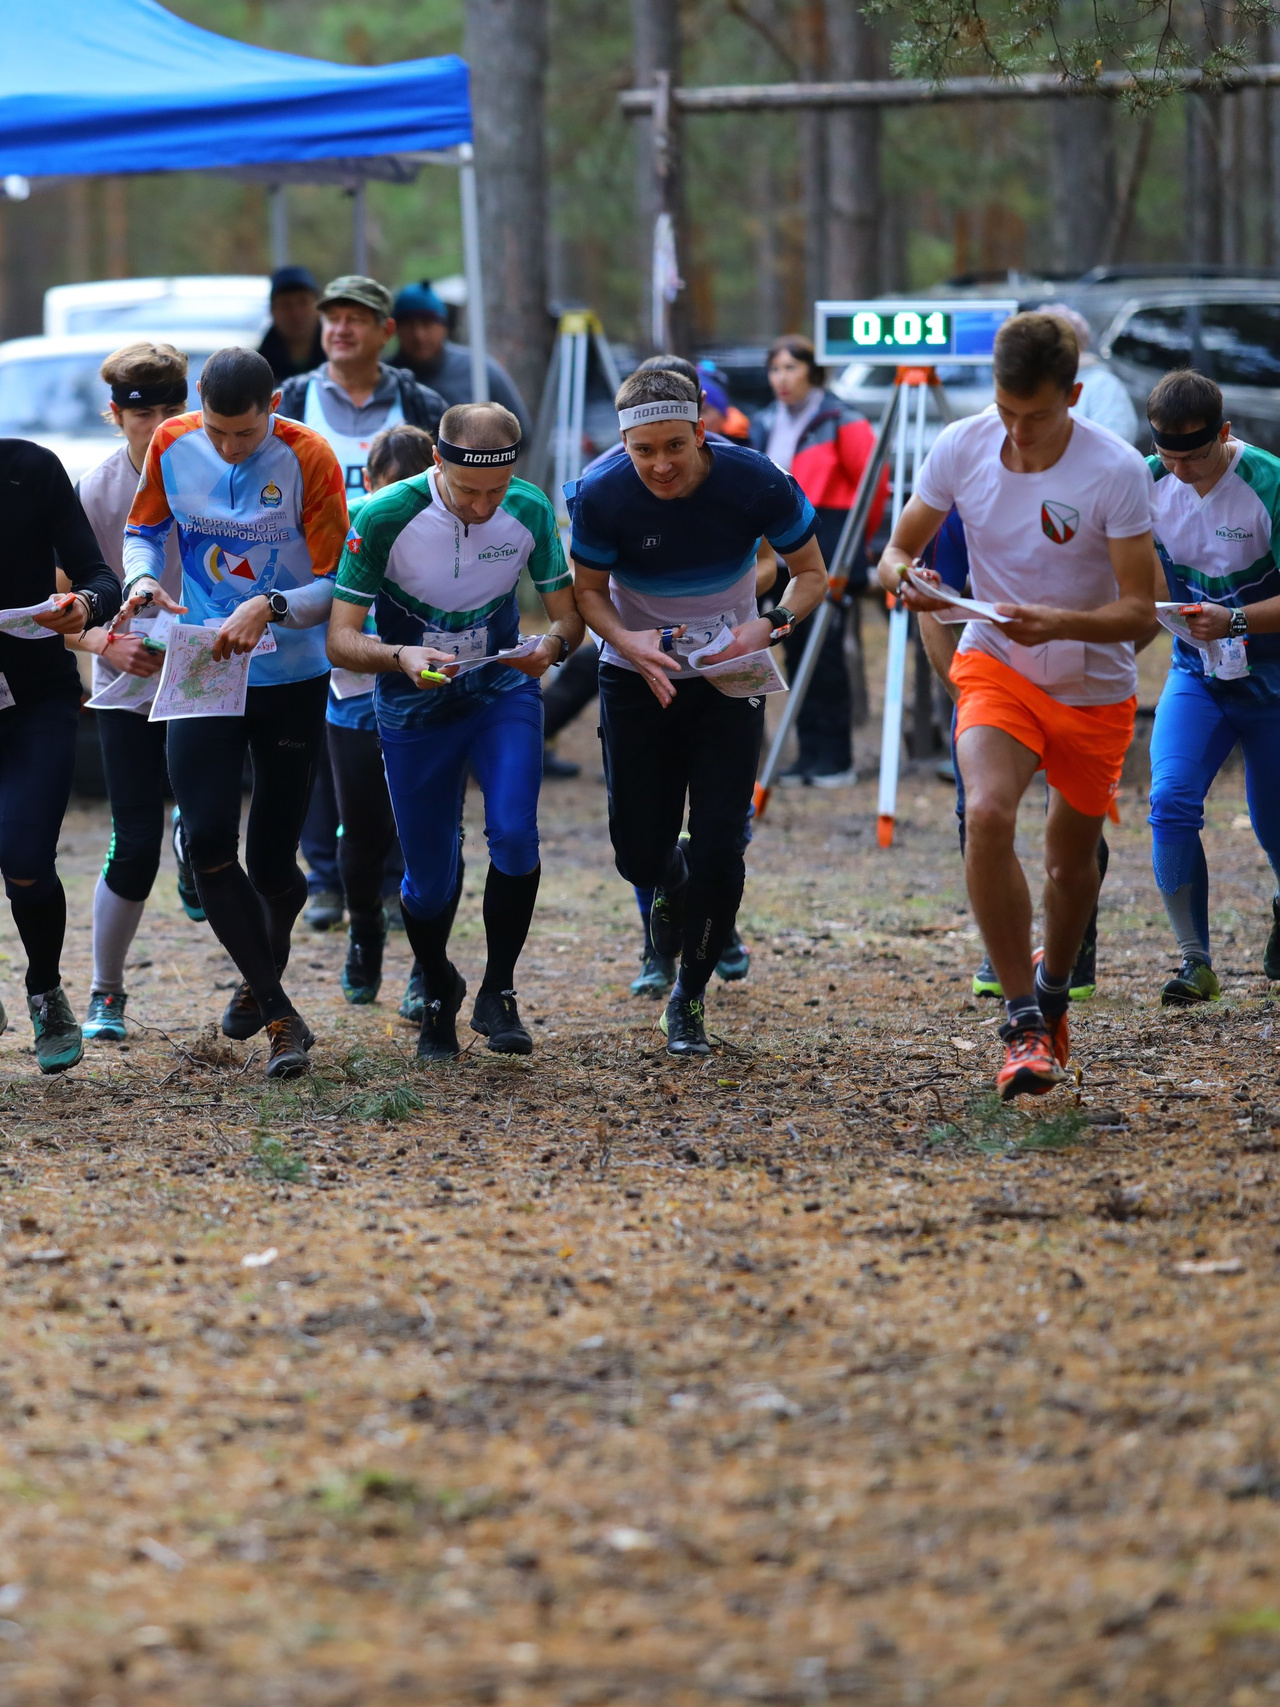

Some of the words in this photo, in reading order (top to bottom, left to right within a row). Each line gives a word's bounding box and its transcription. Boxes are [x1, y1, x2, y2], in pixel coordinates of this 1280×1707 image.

[852, 311, 947, 345] 0.01
[633, 404, 689, 420] noname
[463, 450, 516, 463] noname
[187, 513, 279, 533] СПОРТИВНОЕ
[1215, 529, 1254, 539] EKB-O-TEAM
[478, 548, 519, 560] EKB-O-TEAM
[704, 631, 713, 645] 2
[451, 645, 460, 656] 3
